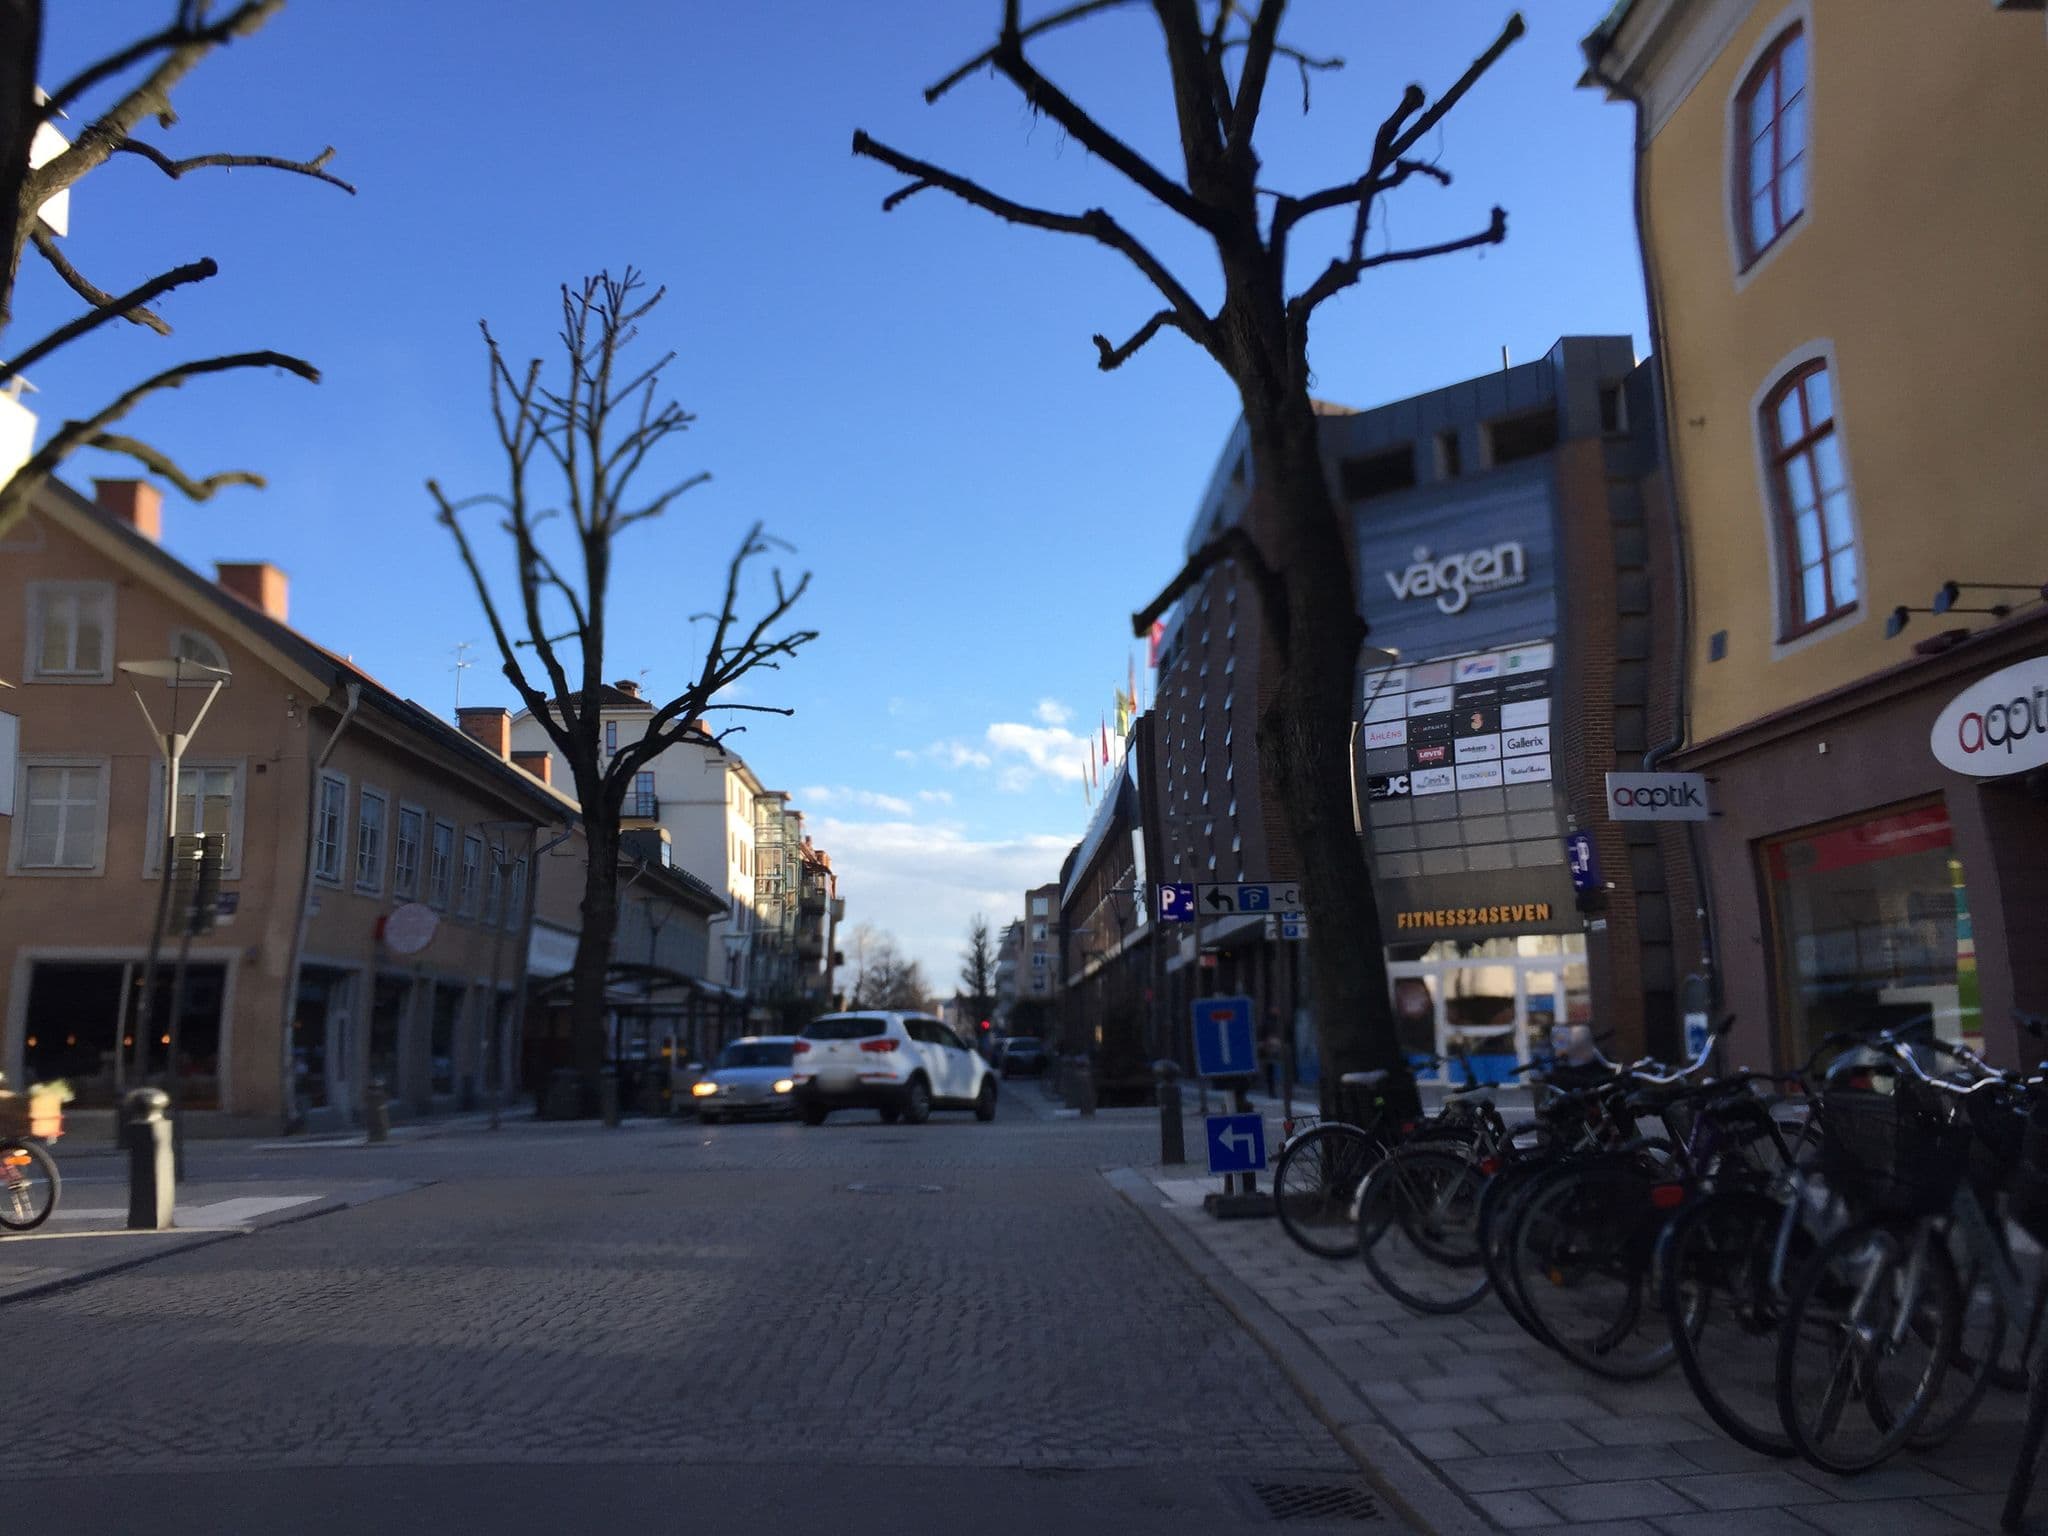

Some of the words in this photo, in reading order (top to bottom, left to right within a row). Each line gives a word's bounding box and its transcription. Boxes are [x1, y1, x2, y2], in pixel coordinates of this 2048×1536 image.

[1385, 542, 1525, 614] vågen
[1507, 737, 1543, 750] Gallerix
[1386, 776, 1409, 796] JC
[1161, 889, 1176, 911] P
[1396, 903, 1551, 929] FITNESS24SEVEN
